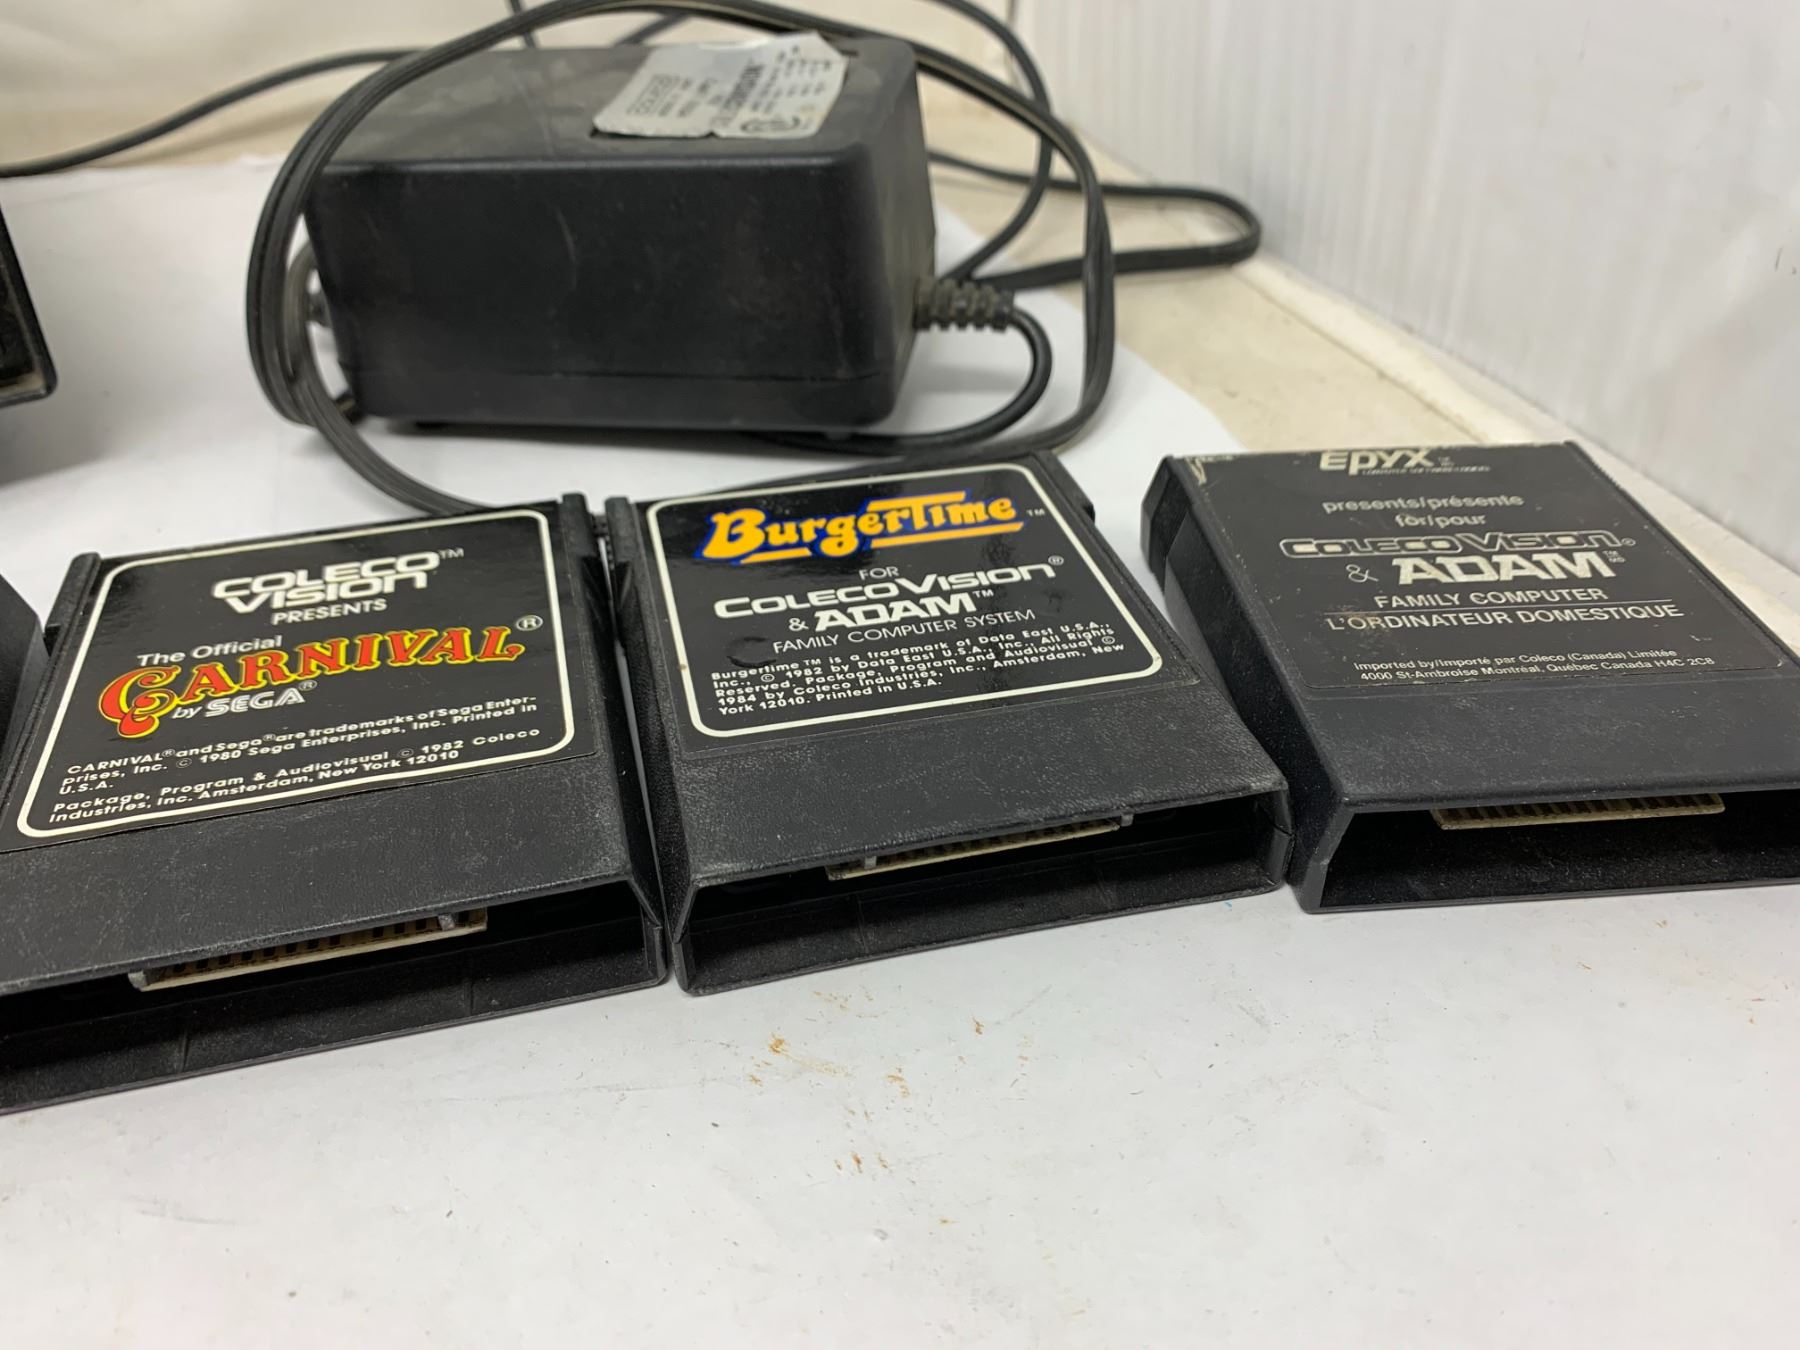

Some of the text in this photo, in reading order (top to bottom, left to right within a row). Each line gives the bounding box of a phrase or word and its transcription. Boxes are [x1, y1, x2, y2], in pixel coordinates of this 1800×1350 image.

[1322, 493, 1525, 514] presents/présente
[1395, 513, 1486, 529] for/pour
[697, 489, 1020, 560] BurgerTime
[212, 550, 440, 598] COLECO
[859, 566, 899, 580] FOR
[1346, 564, 1380, 583] &
[1391, 551, 1617, 585] ADAM
[271, 599, 387, 625] PRESENTS
[788, 617, 808, 632] &
[814, 592, 977, 632] ADAM
[1374, 587, 1608, 609] FAMILY COMPUTER
[773, 609, 1036, 654] FAMILY COMPUTER SYSTEM
[1325, 604, 1684, 632] L'ORDINATEUR DOMESTIQUE
[137, 635, 283, 667] The Official
[711, 662, 799, 681] Burgertime
[829, 656, 842, 665] is
[867, 641, 948, 660] trademark
[956, 637, 970, 647] of
[978, 633, 1015, 644] Data
[1022, 627, 1053, 638] East
[715, 680, 796, 698] Reserved.
[805, 669, 881, 685] Package,
[889, 658, 956, 675] Program
[966, 652, 996, 662] and
[1004, 639, 1093, 658] Audiovisual
[785, 667, 823, 679] 1982
[830, 664, 850, 674] by
[858, 658, 895, 669] Data
[903, 648, 935, 663] East
[1041, 636, 1060, 645] All
[1068, 627, 1115, 641] Rights
[1353, 660, 1416, 671] Imported
[1494, 657, 1516, 666] par
[1518, 652, 1565, 663] Coleco
[1568, 651, 1626, 662] (Canada)
[1627, 649, 1677, 659] Limitée
[1360, 671, 1392, 681] 4000
[1396, 668, 1479, 680] St-Ambroise
[1546, 661, 1599, 672] Québec
[1600, 661, 1652, 670] Canada
[1654, 658, 1685, 668] H4C
[1687, 657, 1715, 665] 2C8
[98, 626, 525, 738] CARNIVAL
[718, 694, 757, 706] 1984
[765, 691, 785, 701] by
[793, 682, 850, 696] Coleco
[859, 670, 944, 687] Industries,
[993, 649, 1086, 668] Amsterdam,
[1092, 644, 1124, 654] New
[172, 706, 200, 719] by
[205, 687, 305, 718] SEGA
[719, 678, 942, 715] York 12010. Printed in U.S.A.
[62, 771, 125, 787] prises,
[134, 763, 167, 774] Inc.
[200, 751, 241, 764] 1980
[247, 742, 295, 757] Sega
[301, 727, 406, 748] Enterprises,
[413, 719, 446, 730] Inc.
[453, 707, 515, 724] Printed
[521, 703, 537, 713] in
[67, 754, 163, 774] CARNIVAL
[175, 745, 212, 758] and
[217, 738, 262, 753] Sega
[275, 732, 305, 743] are
[308, 715, 414, 737] trademarks
[417, 709, 434, 720] of
[437, 704, 483, 718] Sega
[486, 696, 537, 710] Enter-
[49, 750, 459, 824] Industries, Inc. Amsterdam, New York 12010
[53, 792, 150, 813] Package,
[160, 776, 243, 797] Program
[253, 771, 266, 782] &
[275, 751, 388, 778] Audiovisual
[421, 740, 464, 753] 1982
[472, 729, 540, 746] Coleco
[59, 782, 113, 795] U.S.A.
